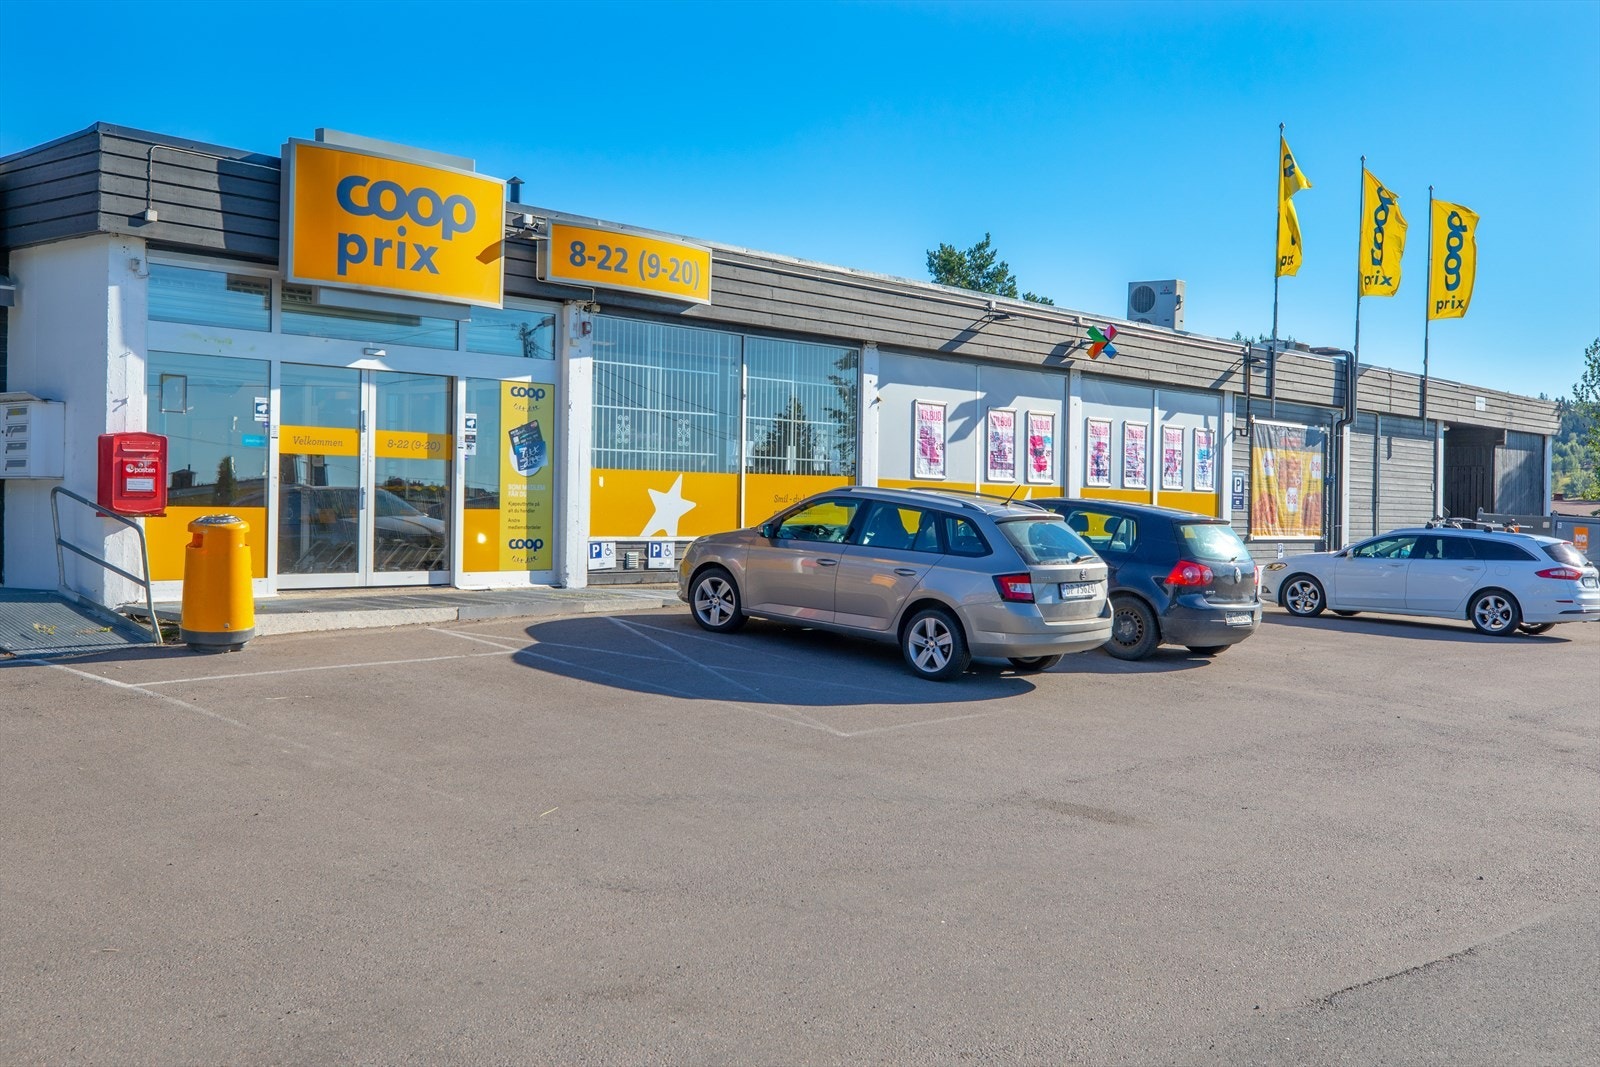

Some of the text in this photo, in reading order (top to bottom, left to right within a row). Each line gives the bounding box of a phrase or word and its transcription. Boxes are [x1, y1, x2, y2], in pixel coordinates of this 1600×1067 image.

[336, 175, 477, 241] coop
[1371, 186, 1394, 266] coop
[337, 225, 440, 276] prix
[1444, 211, 1467, 291] coop
[569, 241, 700, 291] 8-22 (9-20)
[1364, 270, 1392, 291] prix
[1436, 295, 1464, 314] prix
[510, 386, 546, 401] coop
[921, 409, 942, 422] TILBUD
[993, 415, 1012, 428] TILBUD
[1033, 419, 1051, 431] TILBUD
[293, 435, 343, 447] Velkommen
[387, 439, 440, 452] 8-22 (9-20)
[773, 493, 788, 503] Smil
[508, 538, 544, 552] coop
[593, 544, 600, 558] P
[653, 543, 660, 557] P
